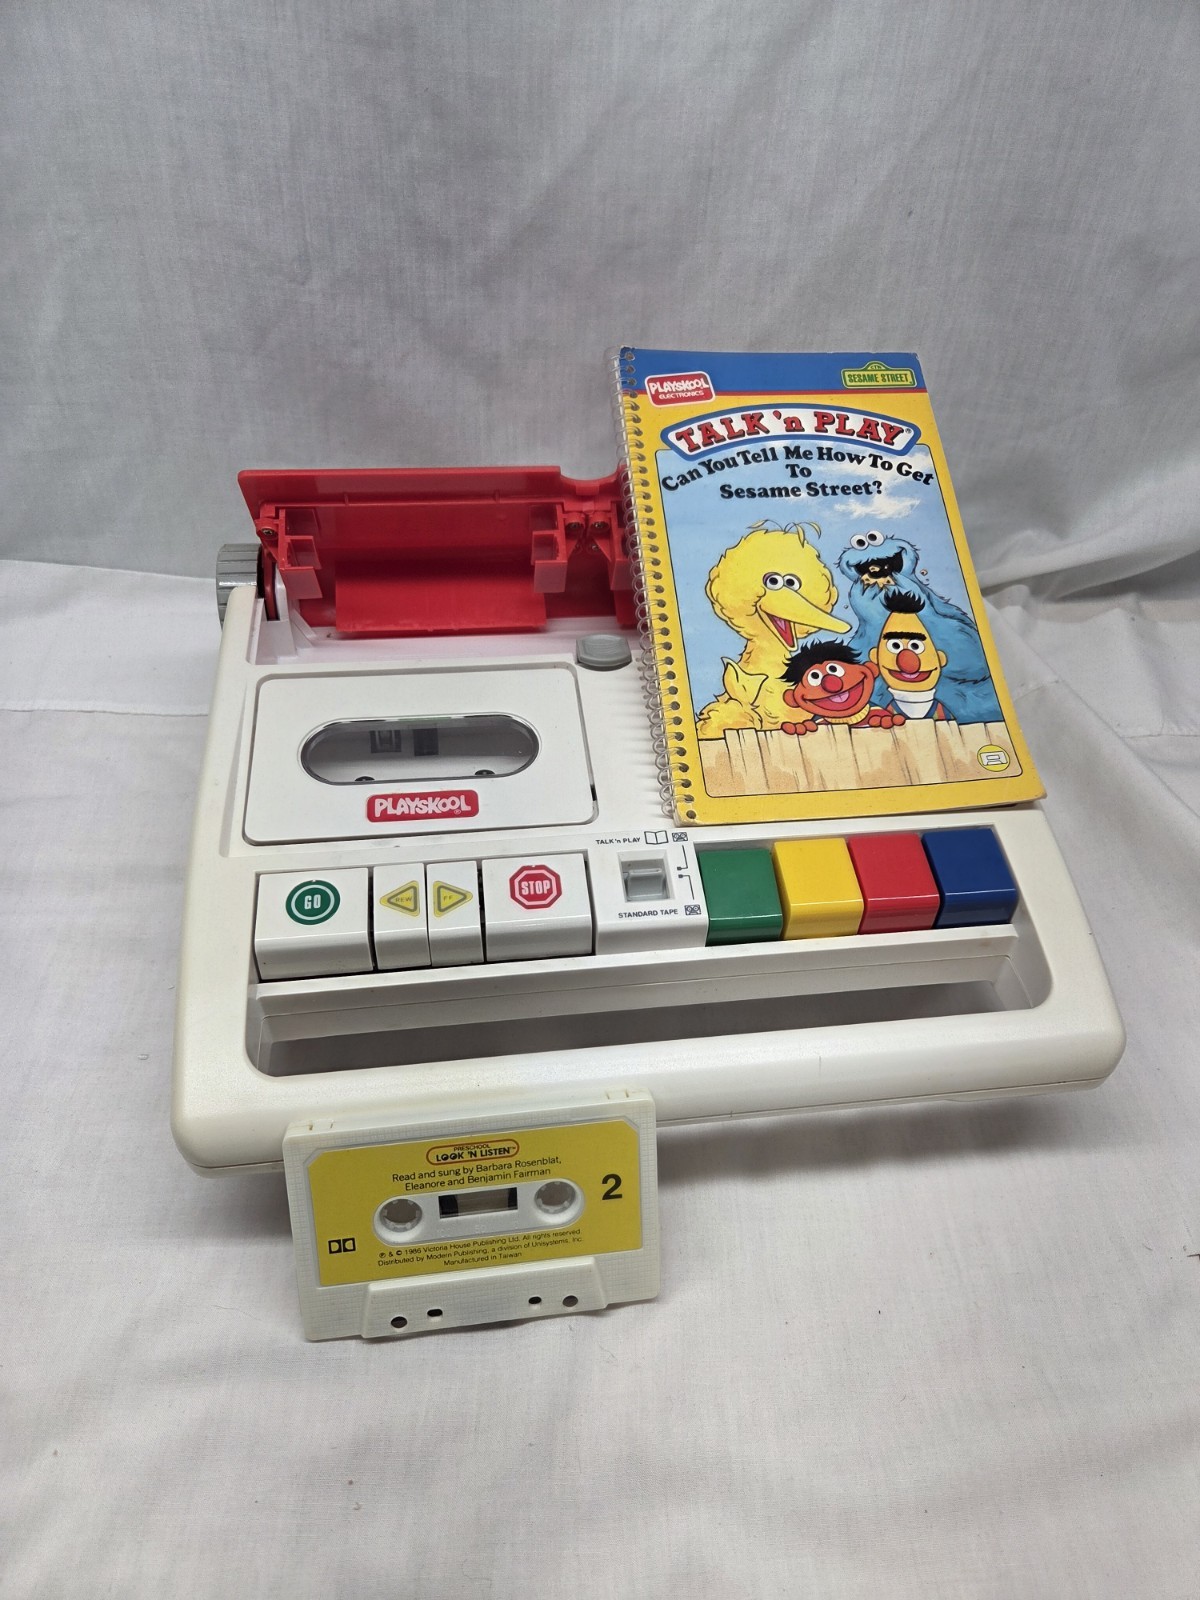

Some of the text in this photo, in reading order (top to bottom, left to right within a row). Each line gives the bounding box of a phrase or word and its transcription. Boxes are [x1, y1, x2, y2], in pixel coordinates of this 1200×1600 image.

[649, 378, 709, 395] PLAYSKOOL
[848, 373, 909, 383] SESAME STREET
[658, 391, 704, 399] ELECTRONICS
[675, 412, 770, 452] TALK
[661, 445, 934, 491] Can You Tell Me How To Get
[785, 463, 812, 478] To
[720, 480, 883, 499] Sesame Street?
[374, 795, 471, 817] PLAYSKOOL
[521, 880, 550, 895] STOP
[304, 894, 321, 910] GO
[618, 910, 658, 918] STANDARD
[453, 1143, 490, 1152] PRESCHOOL
[435, 1151, 464, 1162] LOOK
[392, 1156, 562, 1182] Read and sung by Barbara Rosenblat,
[405, 1168, 551, 1191] Eleanore and Benjamin Fairman
[601, 1174, 623, 1200] 2
[423, 1245, 448, 1253] Victoria
[449, 1242, 471, 1250] House
[473, 1238, 507, 1246] Publishing
[533, 1232, 551, 1240] rights
[377, 1257, 415, 1267] Distributed
[426, 1252, 453, 1260] Modern
[497, 1244, 523, 1252] division
[443, 1256, 489, 1266] Manufactured
[499, 1251, 523, 1259] Taiwan
